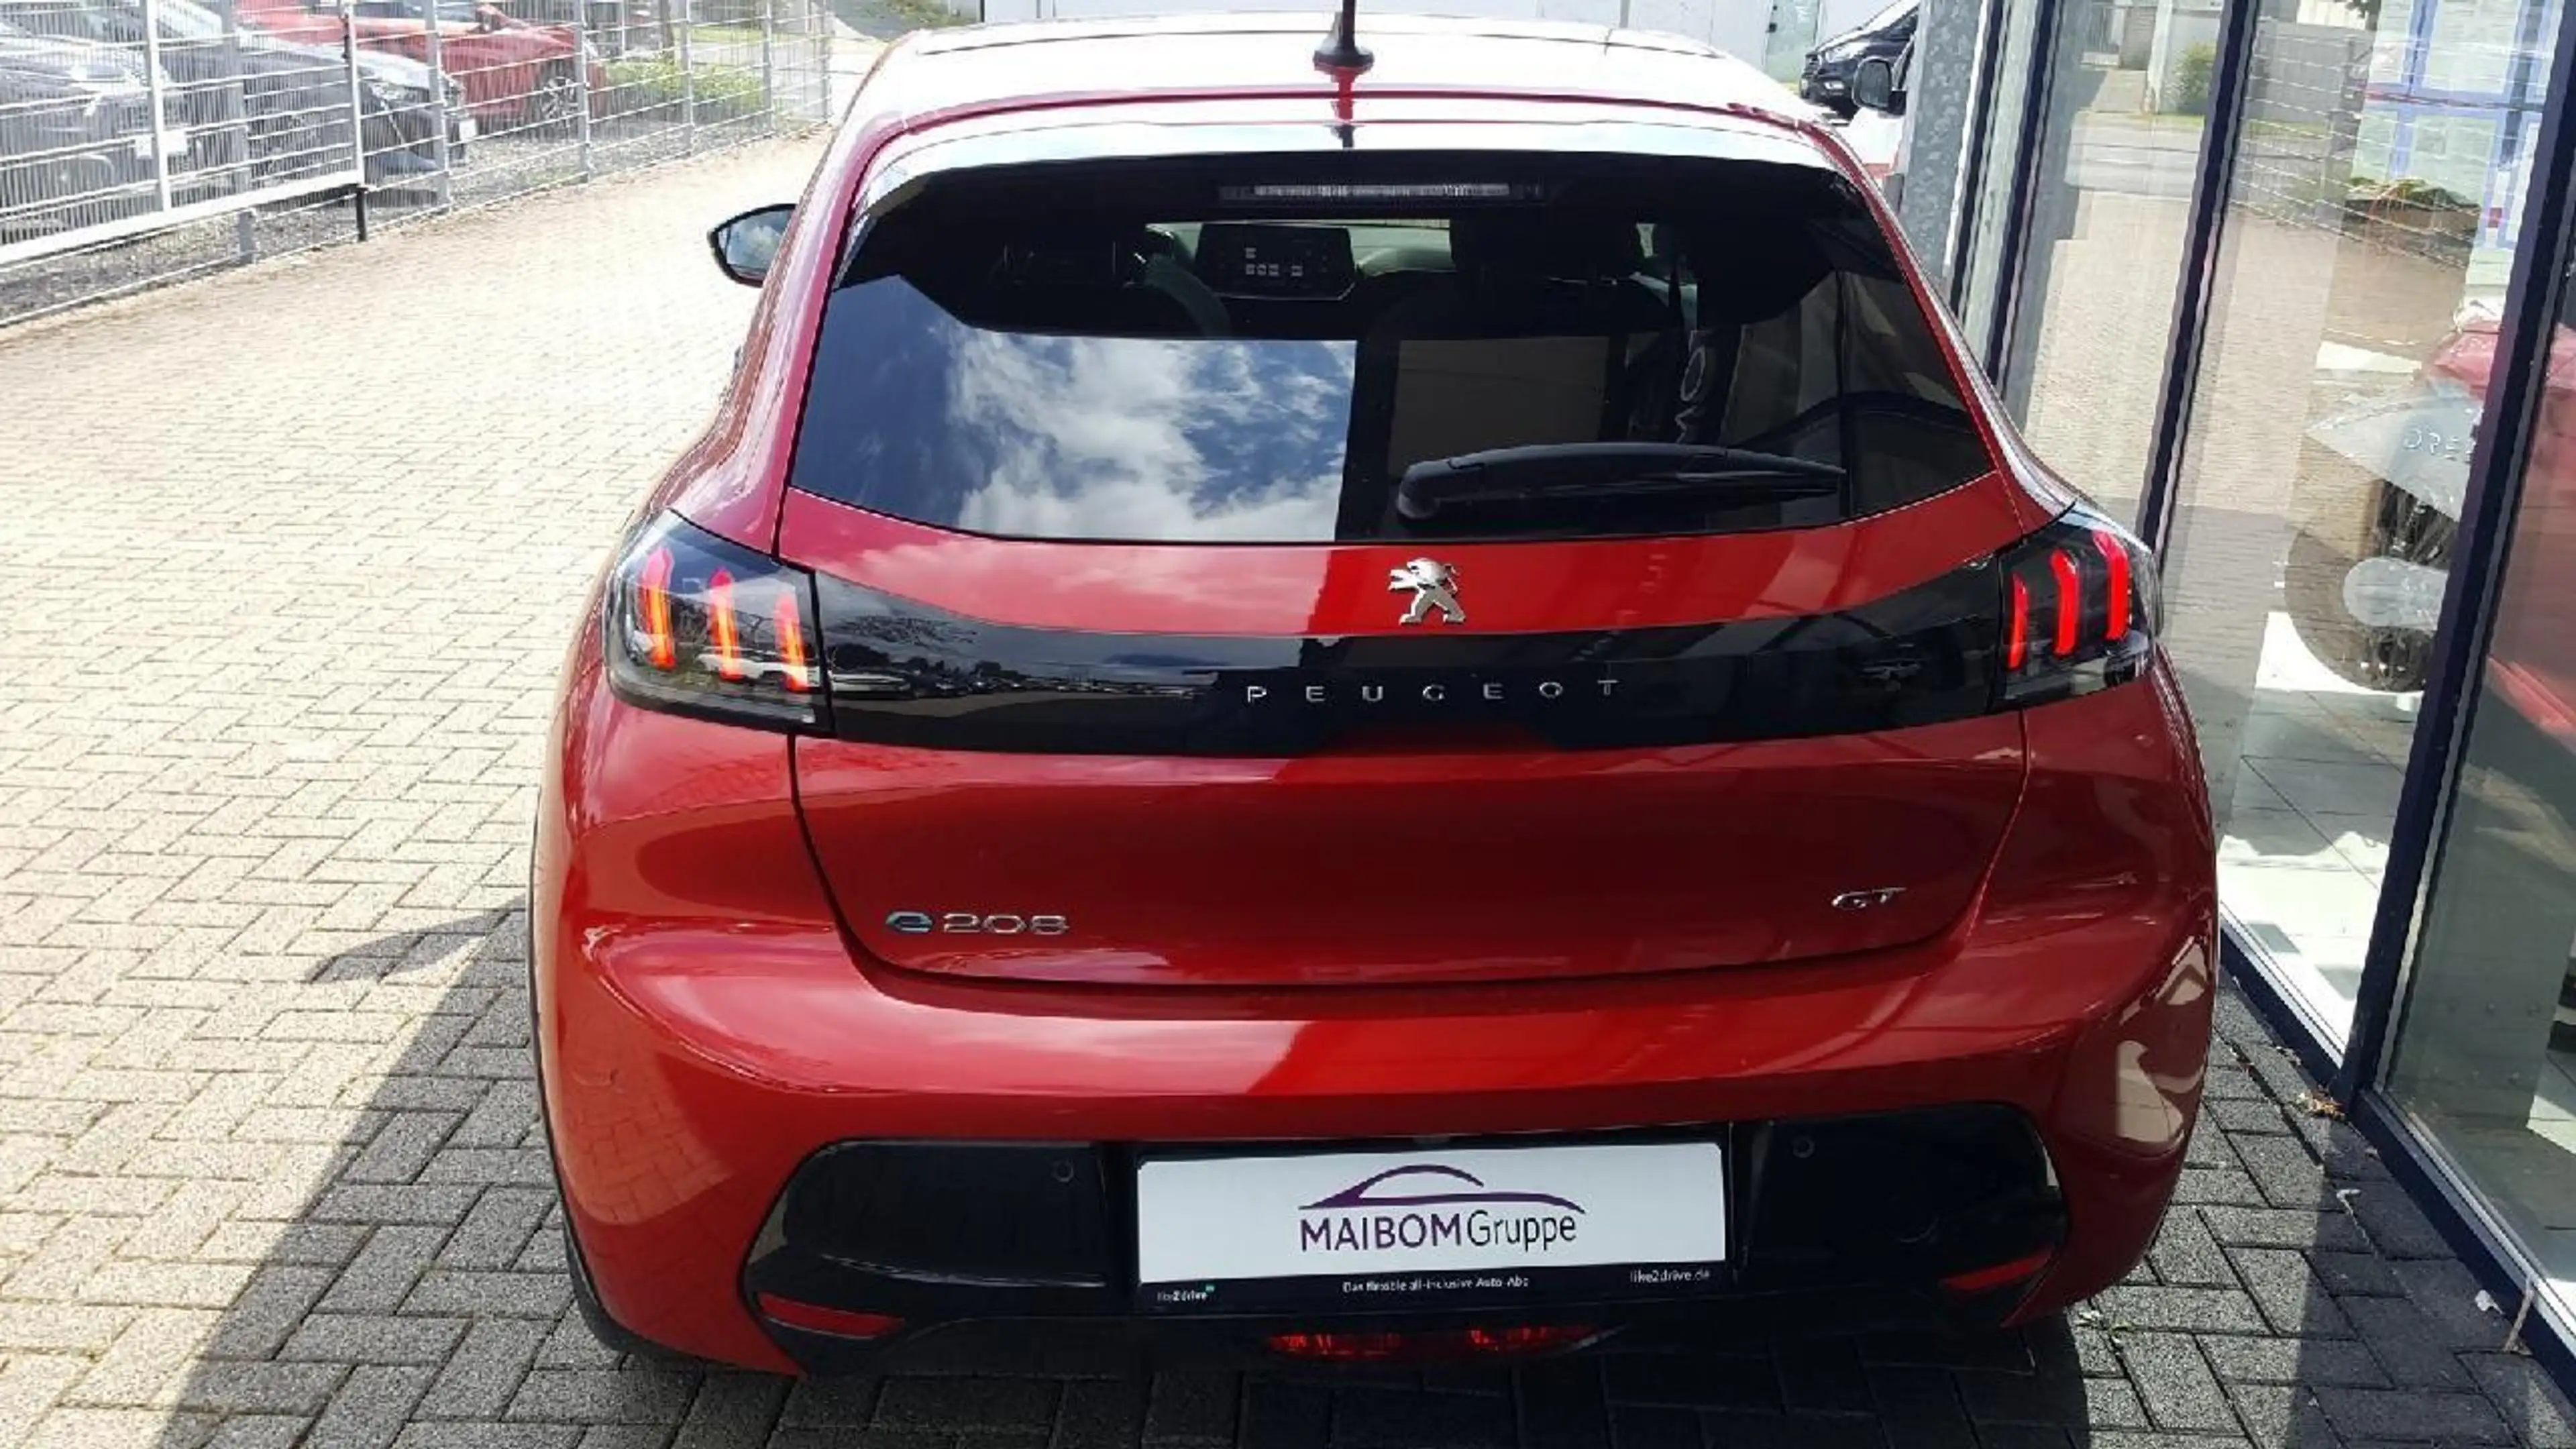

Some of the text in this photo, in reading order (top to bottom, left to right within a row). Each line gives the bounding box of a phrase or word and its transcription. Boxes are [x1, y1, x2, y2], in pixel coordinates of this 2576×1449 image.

[1246, 679, 1619, 703] PEUGEOT
[1831, 886, 1907, 910] GT
[1629, 1267, 1711, 1283] like2drive.de
